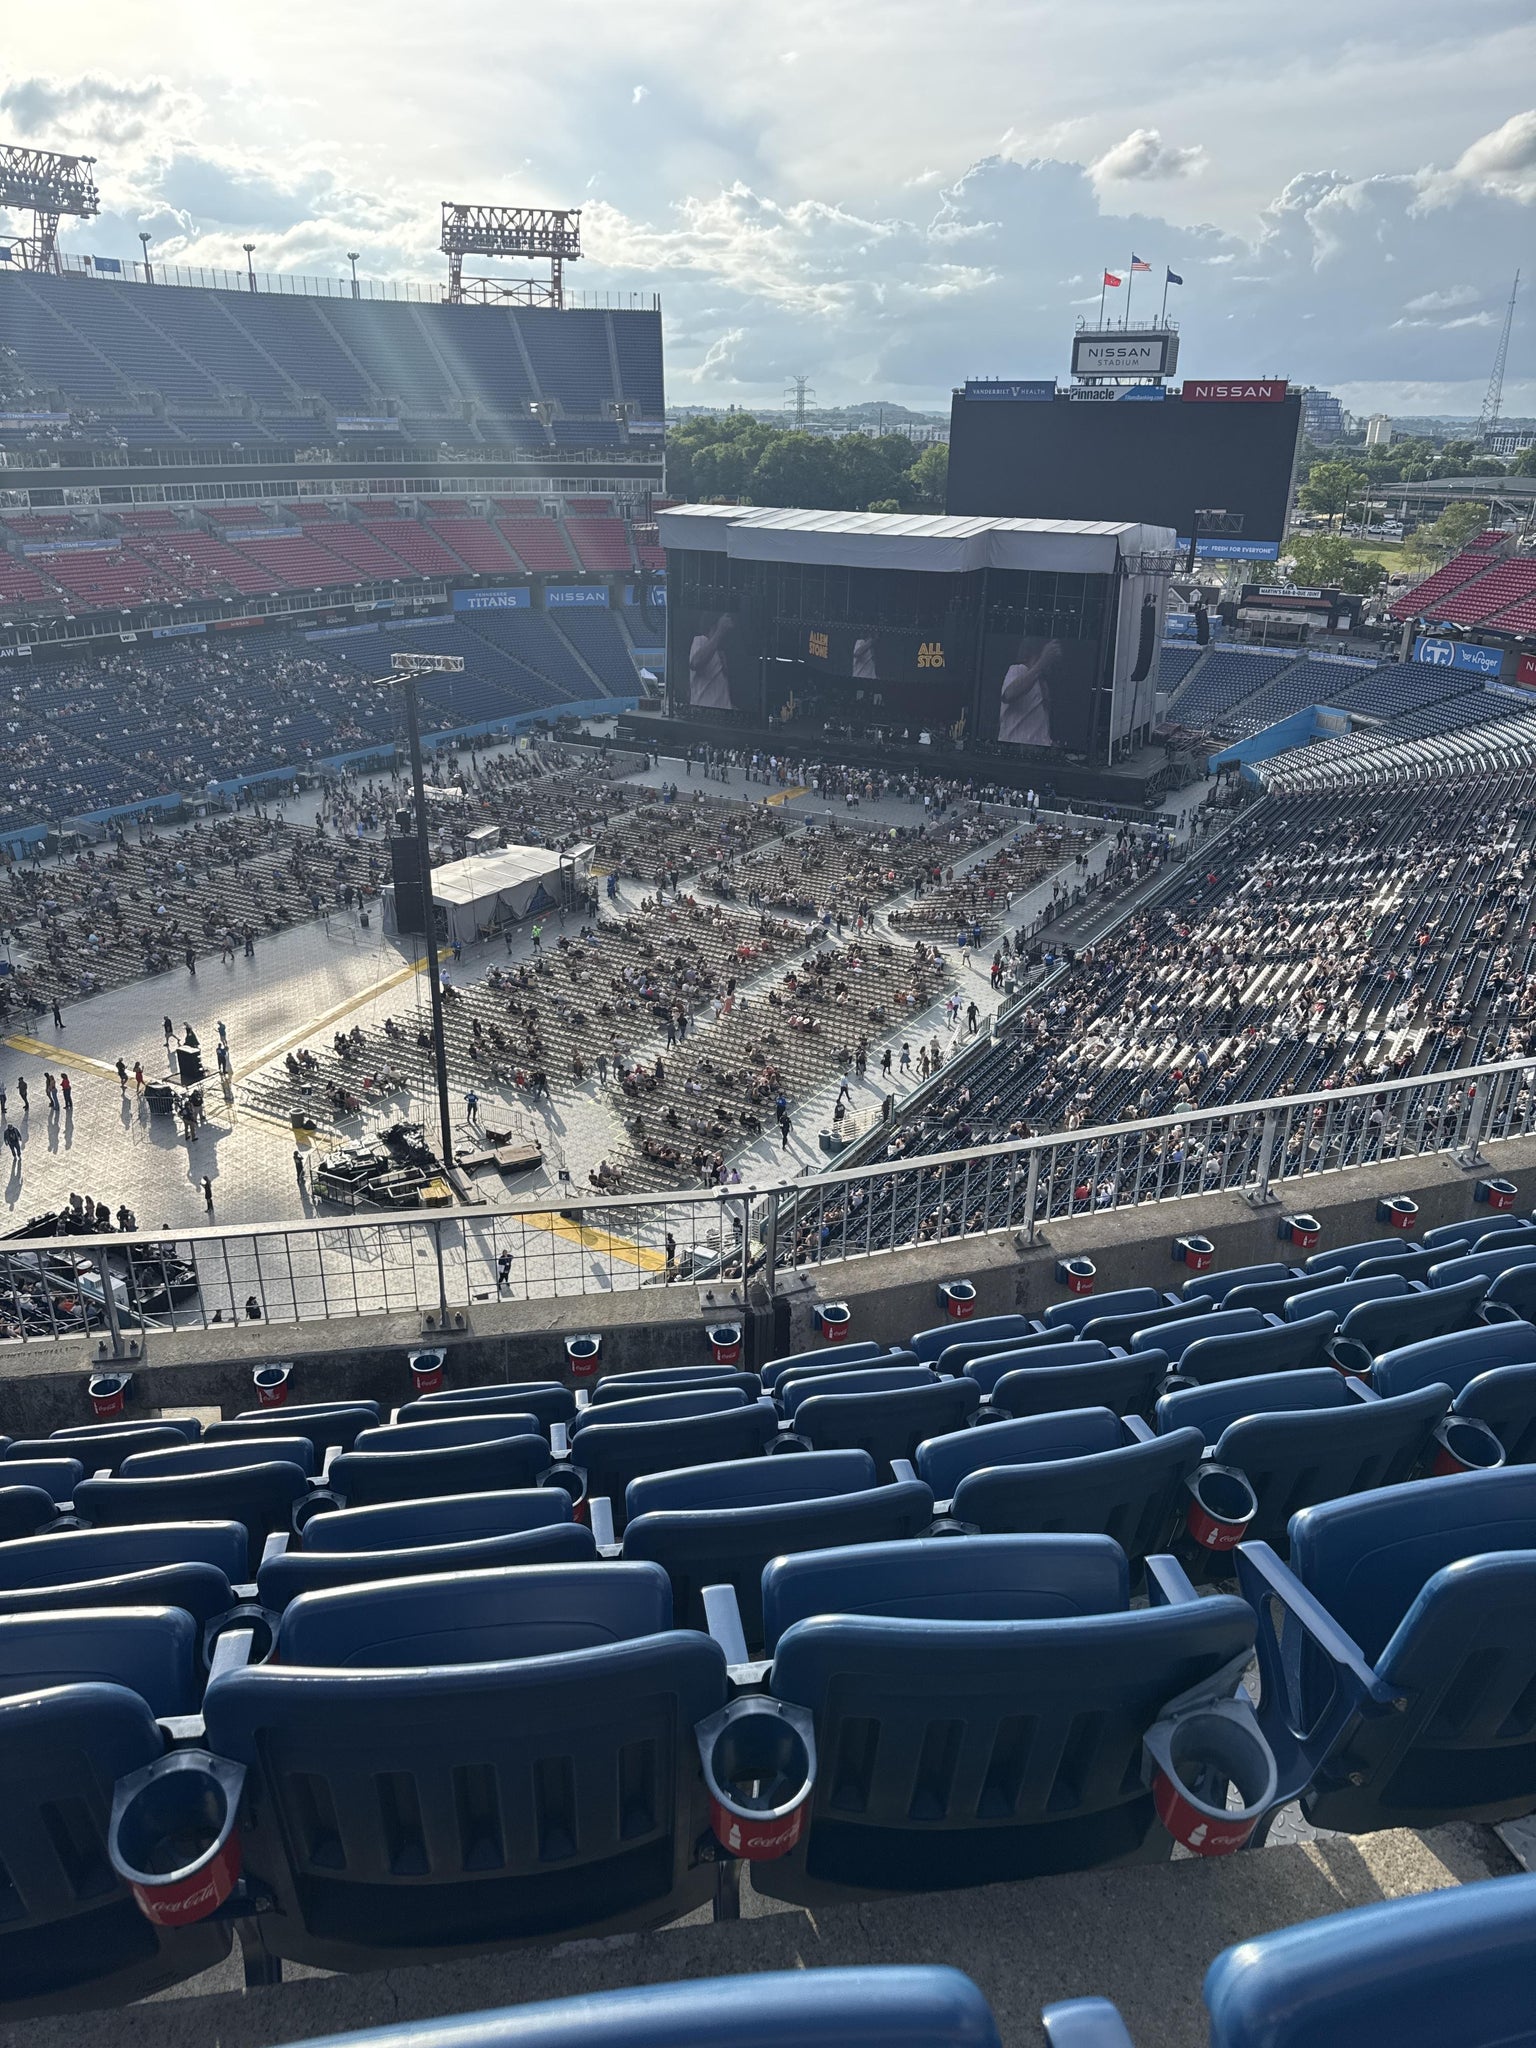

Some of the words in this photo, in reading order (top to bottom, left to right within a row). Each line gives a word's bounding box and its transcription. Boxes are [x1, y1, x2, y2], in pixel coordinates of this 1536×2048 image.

[1088, 347, 1151, 358] NISSAN
[1097, 359, 1139, 367] STADIUM
[972, 388, 1010, 396] VANDERBILT
[1021, 388, 1046, 396] HEALTH
[1070, 385, 1115, 400] Pinnacle
[1195, 386, 1273, 398] NISSAN
[550, 592, 605, 601] NISSAN
[1282, 589, 1306, 597] BAR-B-QUE
[467, 596, 517, 608] TITANS
[1472, 650, 1498, 672] Kroger
[152, 1880, 216, 1913] Coca-Cola
